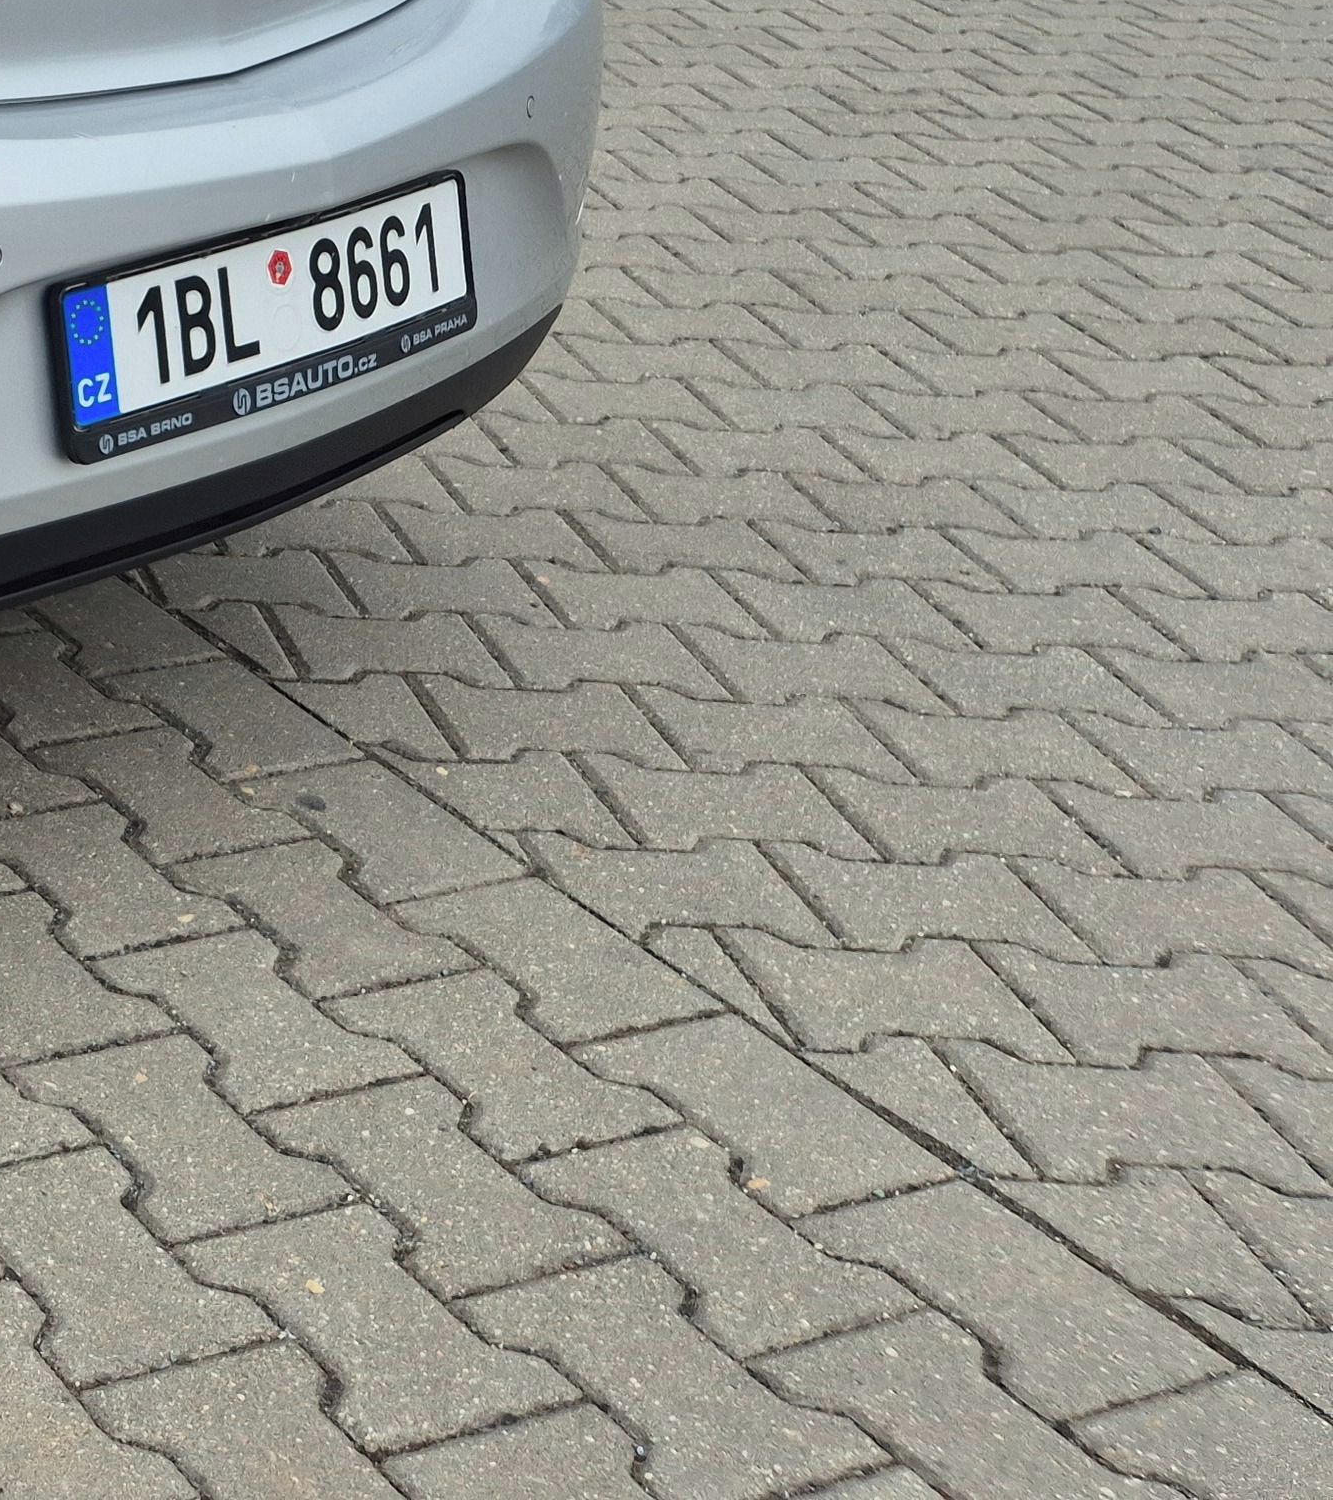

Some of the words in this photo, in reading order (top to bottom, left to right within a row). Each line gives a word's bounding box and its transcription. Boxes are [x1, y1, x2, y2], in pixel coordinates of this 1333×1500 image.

[136, 266, 261, 384] 1BL
[309, 202, 439, 332] 8661
[413, 331, 433, 346] BSA
[434, 313, 468, 337] PRAHA
[77, 372, 112, 408] CZ
[117, 427, 148, 447] BSA
[150, 412, 193, 437] BRNO
